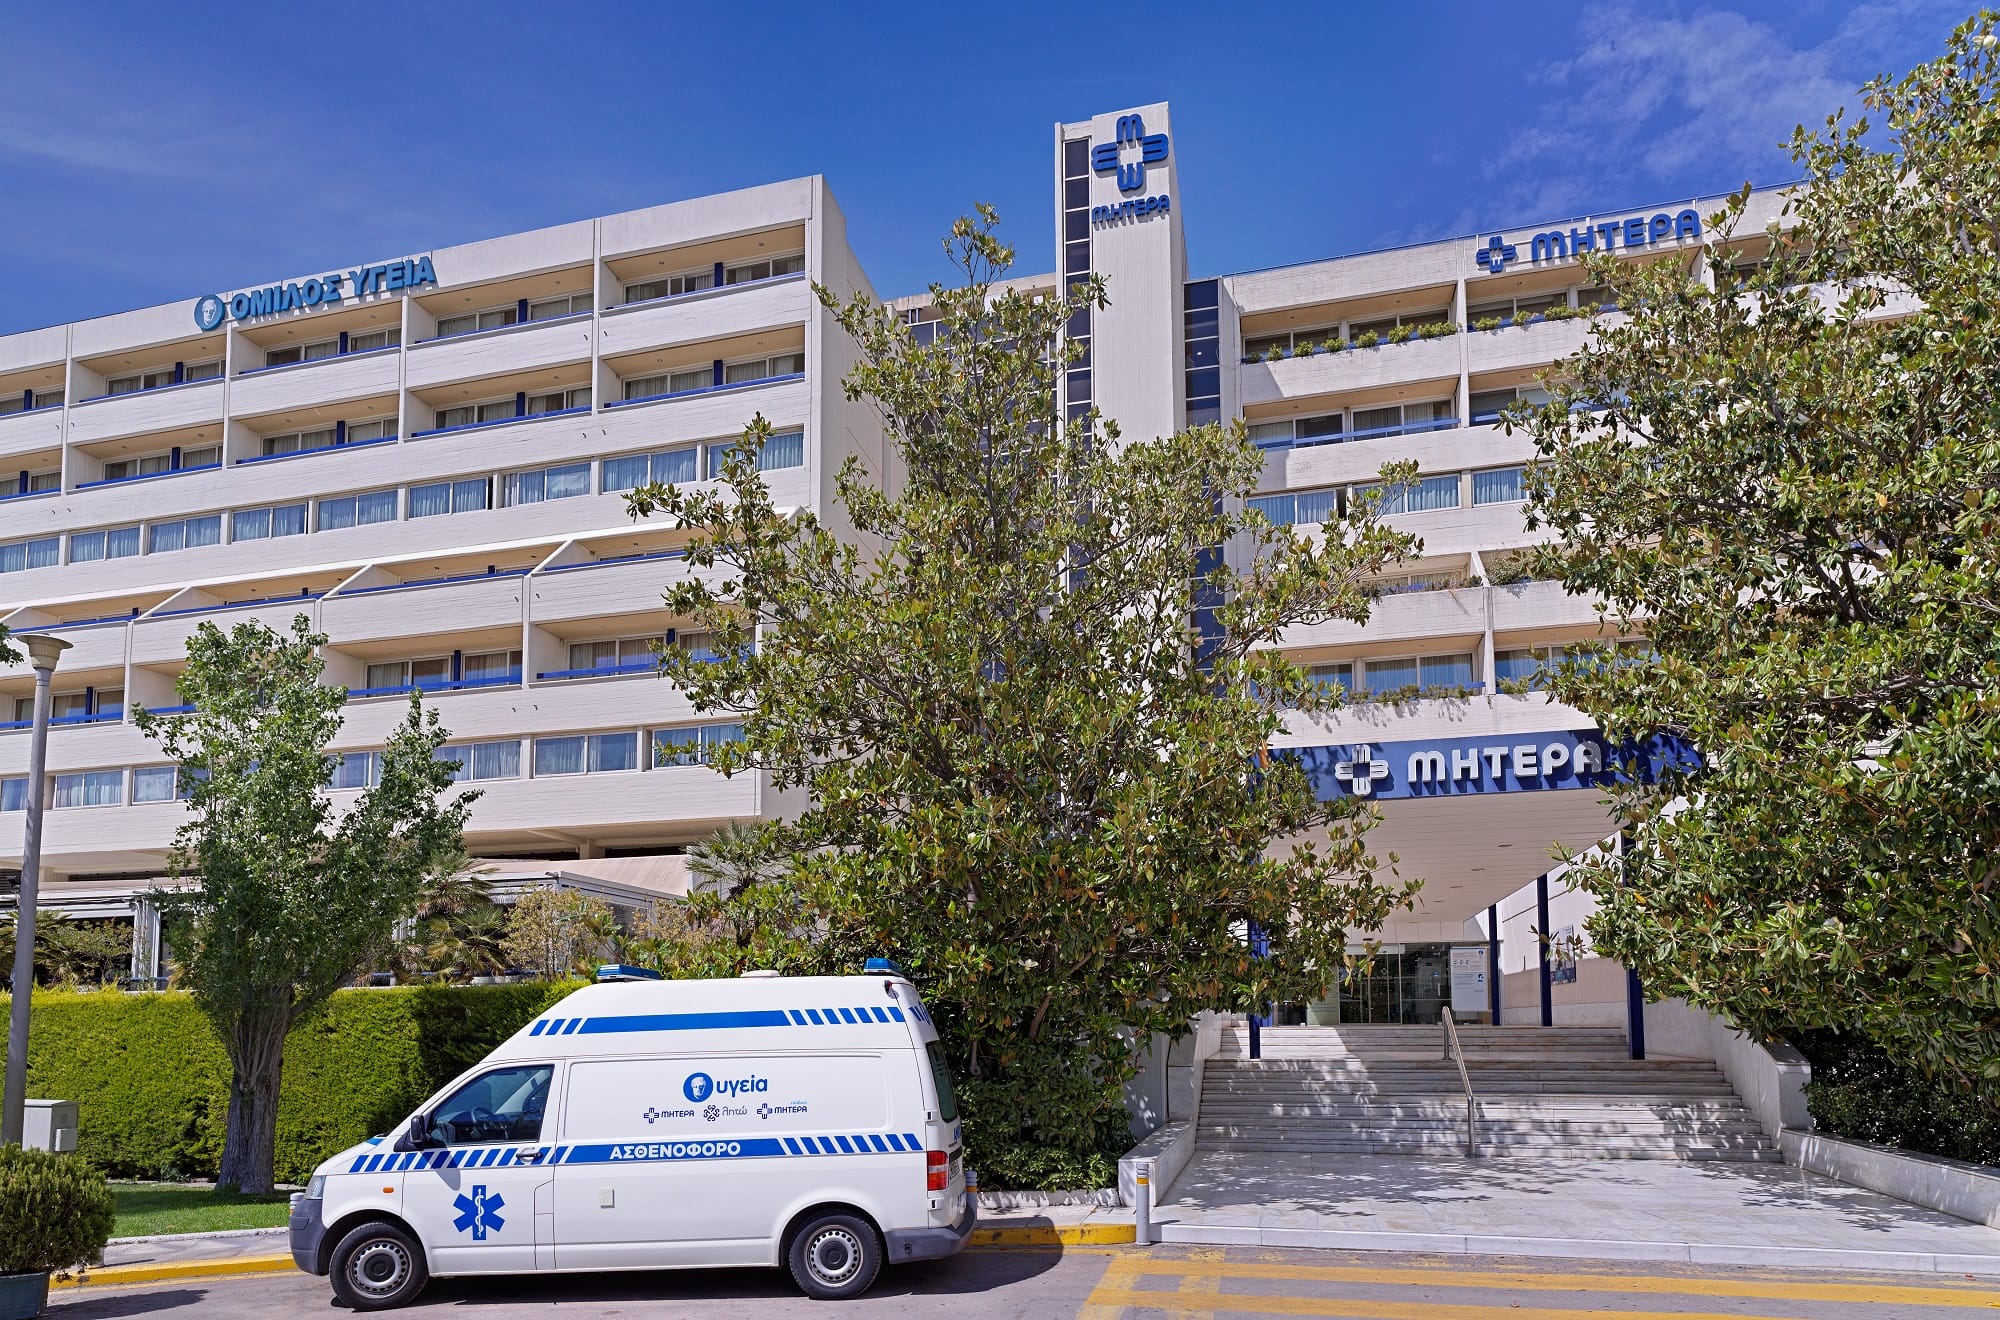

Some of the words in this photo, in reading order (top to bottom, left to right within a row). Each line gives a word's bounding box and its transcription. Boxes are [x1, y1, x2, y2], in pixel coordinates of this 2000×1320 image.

[1092, 194, 1170, 224] ΜΗΤΕΡΑ
[1531, 209, 1700, 262] ΜΗΤΕΡΑ
[231, 274, 341, 320] ΟΜΙΛΟΣ
[348, 256, 436, 296] ΥΓΕΙΑ
[1408, 741, 1602, 783] ΜΗΤΕΡΑ
[716, 1074, 768, 1098] υγεία
[661, 1109, 695, 1118] ΜΗΤΕΡΑ
[774, 1105, 808, 1114] ΜΗΤΕΡΑ
[609, 1142, 741, 1160] ΑΣΘΕΝΟΦΟΡΟ
